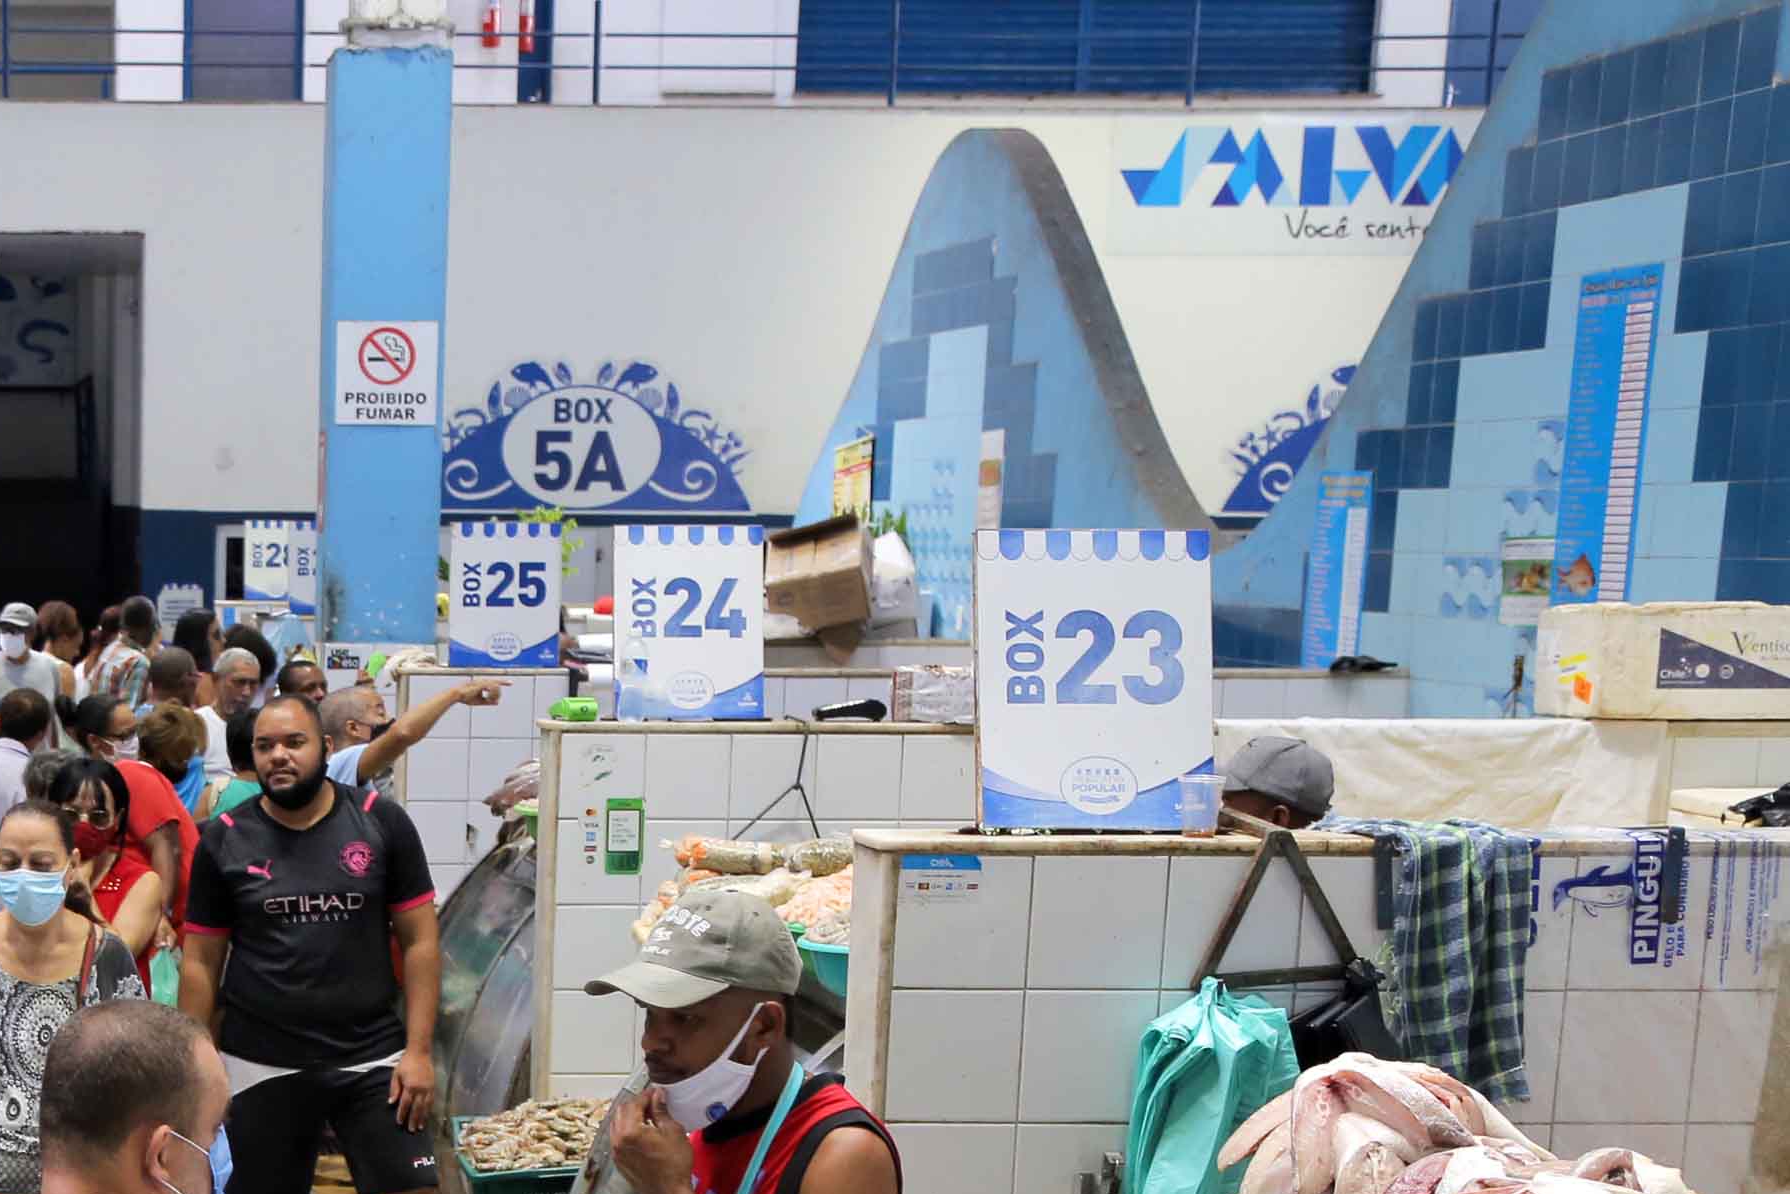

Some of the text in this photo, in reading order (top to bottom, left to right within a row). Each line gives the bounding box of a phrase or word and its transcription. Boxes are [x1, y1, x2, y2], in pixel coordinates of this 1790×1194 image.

[1284, 212, 1352, 240] Você
[344, 391, 428, 405] PROIBIDO
[553, 398, 614, 424] BOX
[355, 407, 416, 421] FUMAR
[533, 429, 627, 492] 5A
[252, 543, 264, 568] BOX
[297, 546, 310, 577] BOX
[462, 561, 547, 607] BOX 25
[631, 576, 747, 638] BOX 24
[1005, 609, 1185, 705] BOX 23
[1072, 783, 1125, 793] POPULAR
[263, 892, 365, 914] ETIHAD
[281, 911, 350, 924] AIRWAYS
[1663, 934, 1675, 968] GELO
